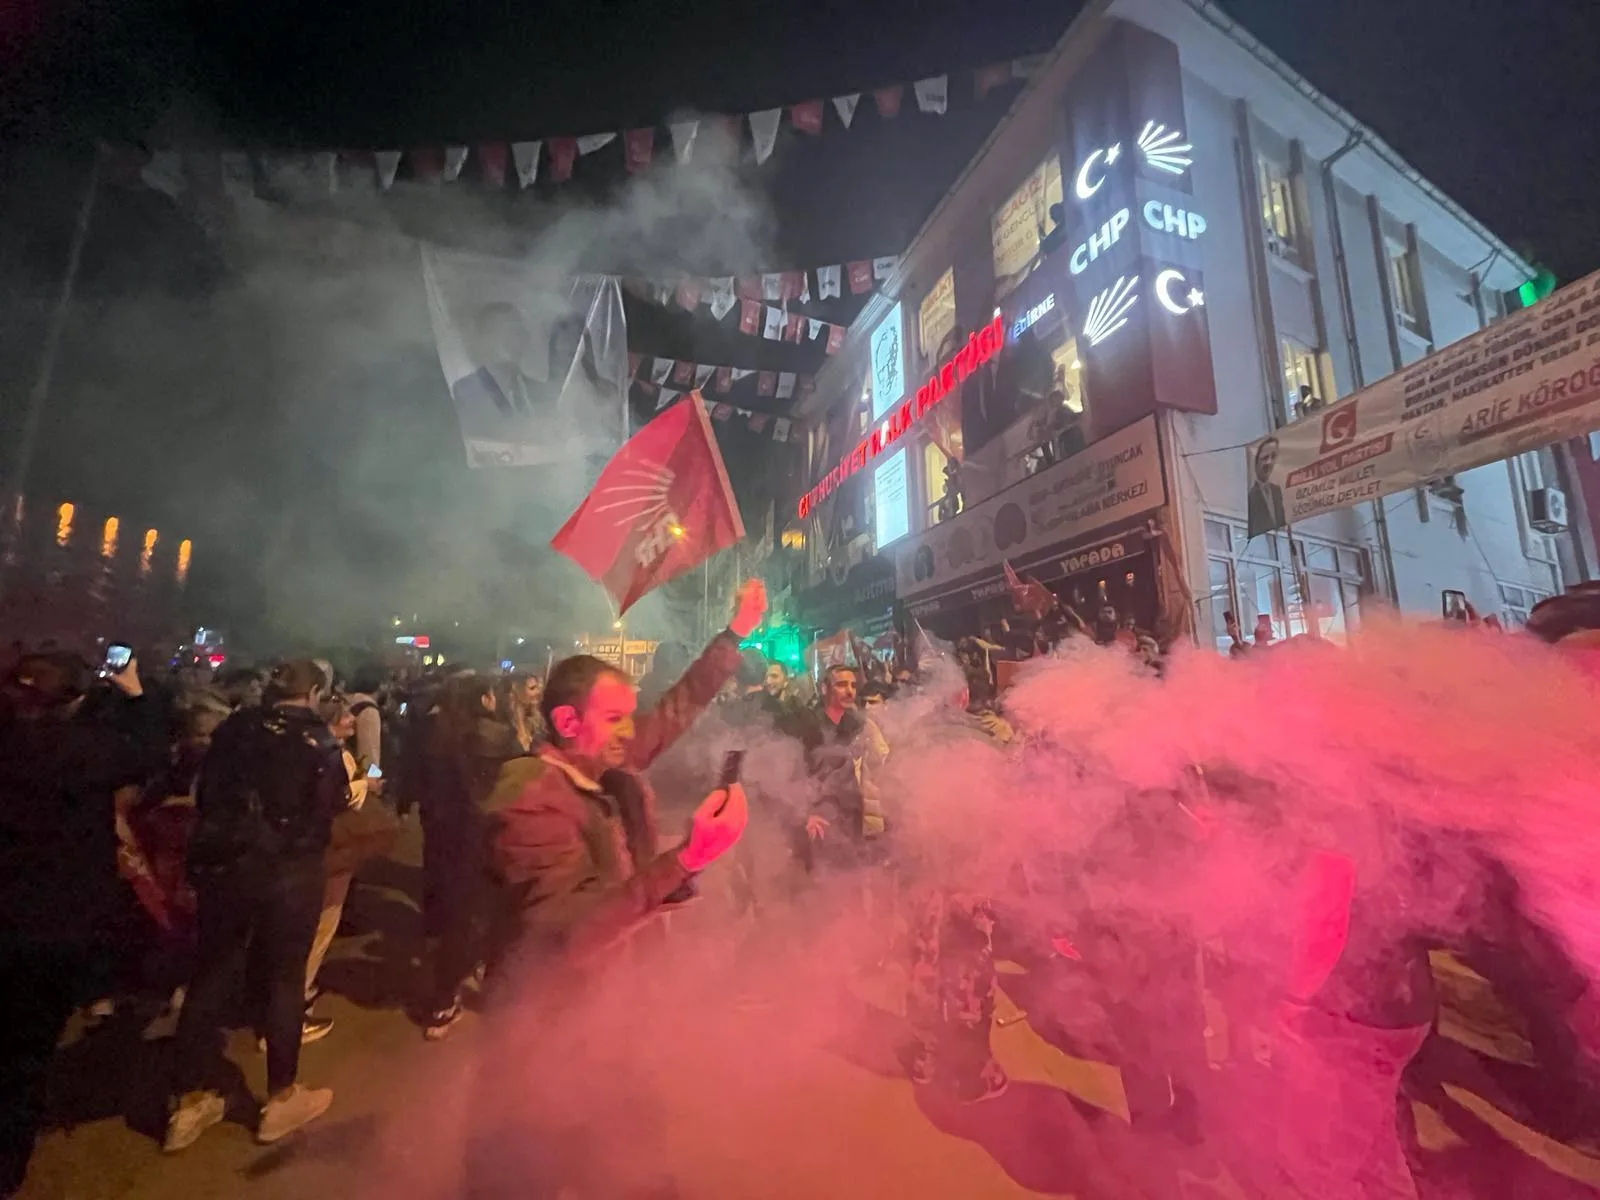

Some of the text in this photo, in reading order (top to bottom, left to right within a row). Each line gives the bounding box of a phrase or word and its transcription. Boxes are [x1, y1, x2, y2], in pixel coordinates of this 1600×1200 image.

[1069, 208, 1130, 275] CHP
[1143, 200, 1207, 240] CHP
[1013, 292, 1056, 339] EDİRNE
[869, 398, 914, 460] HALK
[916, 308, 1004, 420] PARTİSİ
[1461, 397, 1512, 432] ARİF
[1337, 480, 1382, 503] DEVLET
